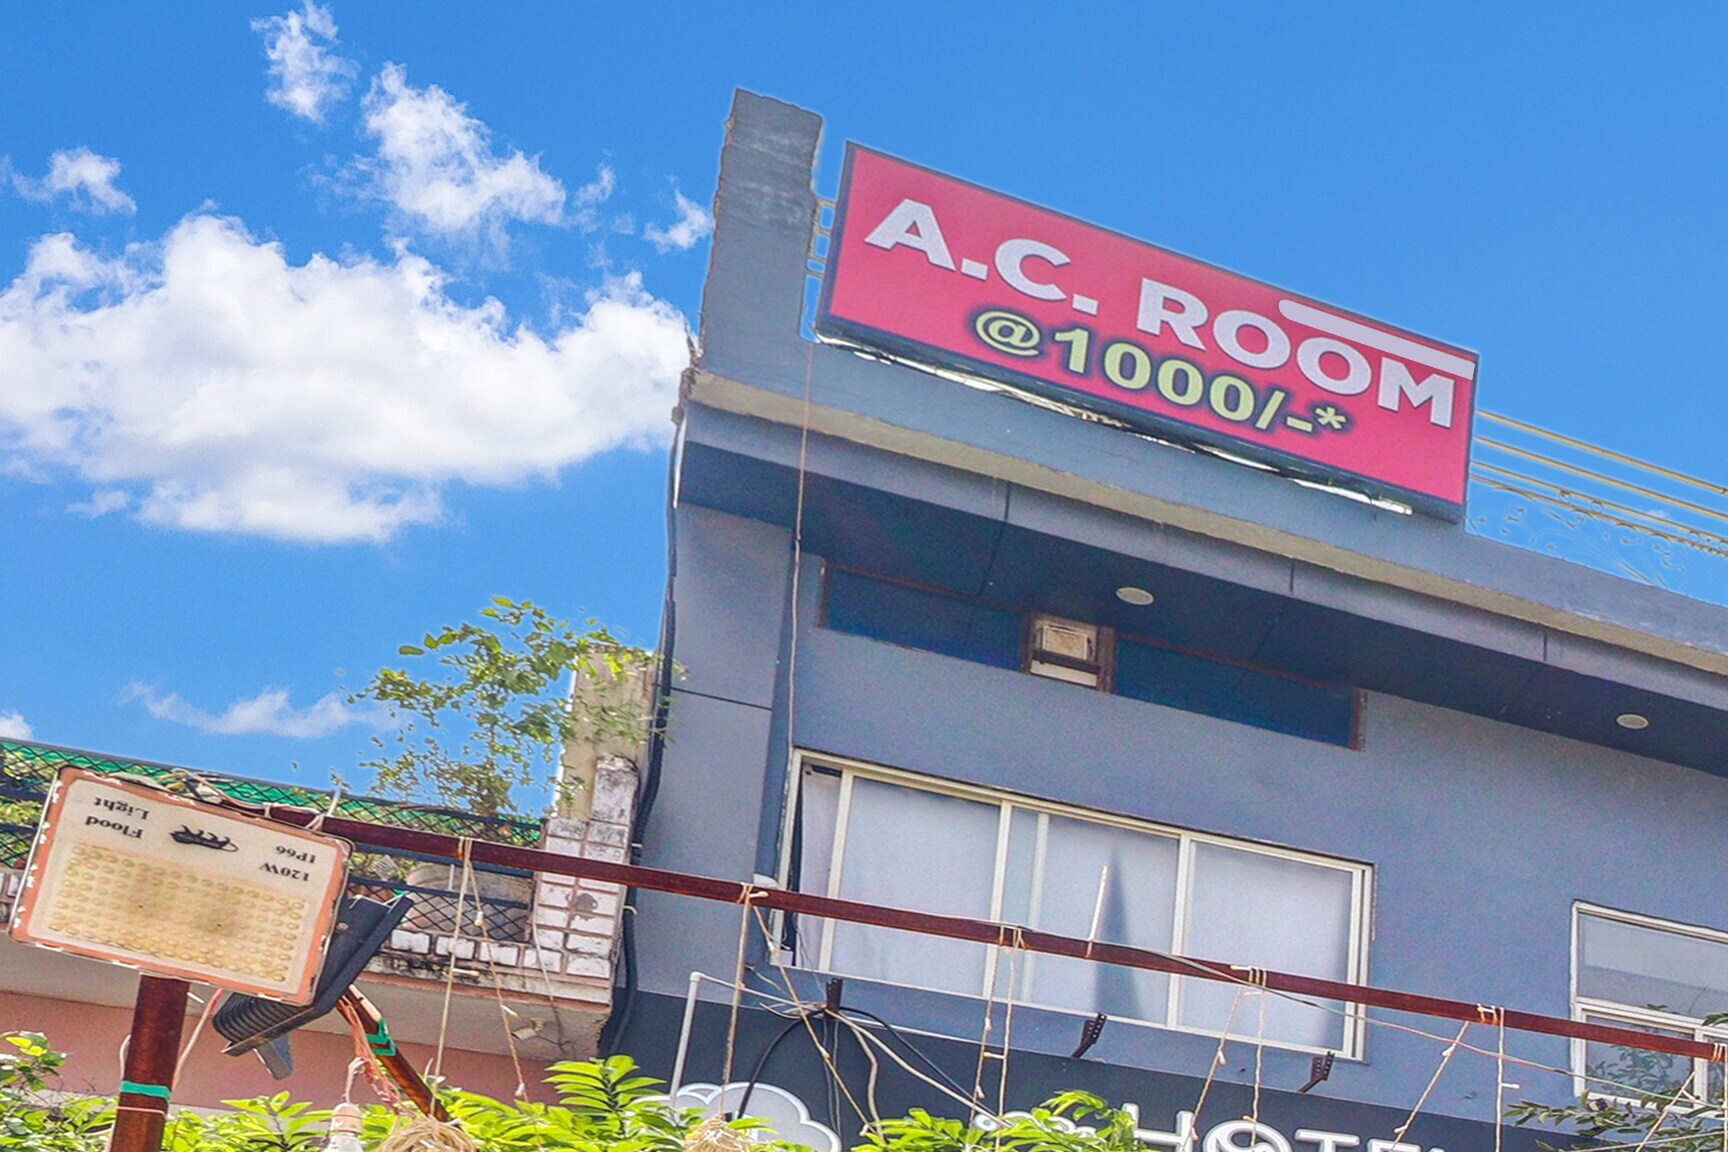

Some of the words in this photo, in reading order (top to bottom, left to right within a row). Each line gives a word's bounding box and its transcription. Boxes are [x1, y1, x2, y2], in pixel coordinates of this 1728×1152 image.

[865, 198, 1098, 315] A.C.
[1136, 278, 1455, 428] ROOM
[94, 797, 149, 820] Light
[85, 815, 143, 839] Flood
[276, 844, 316, 863] IP66
[260, 861, 309, 882] 120W
